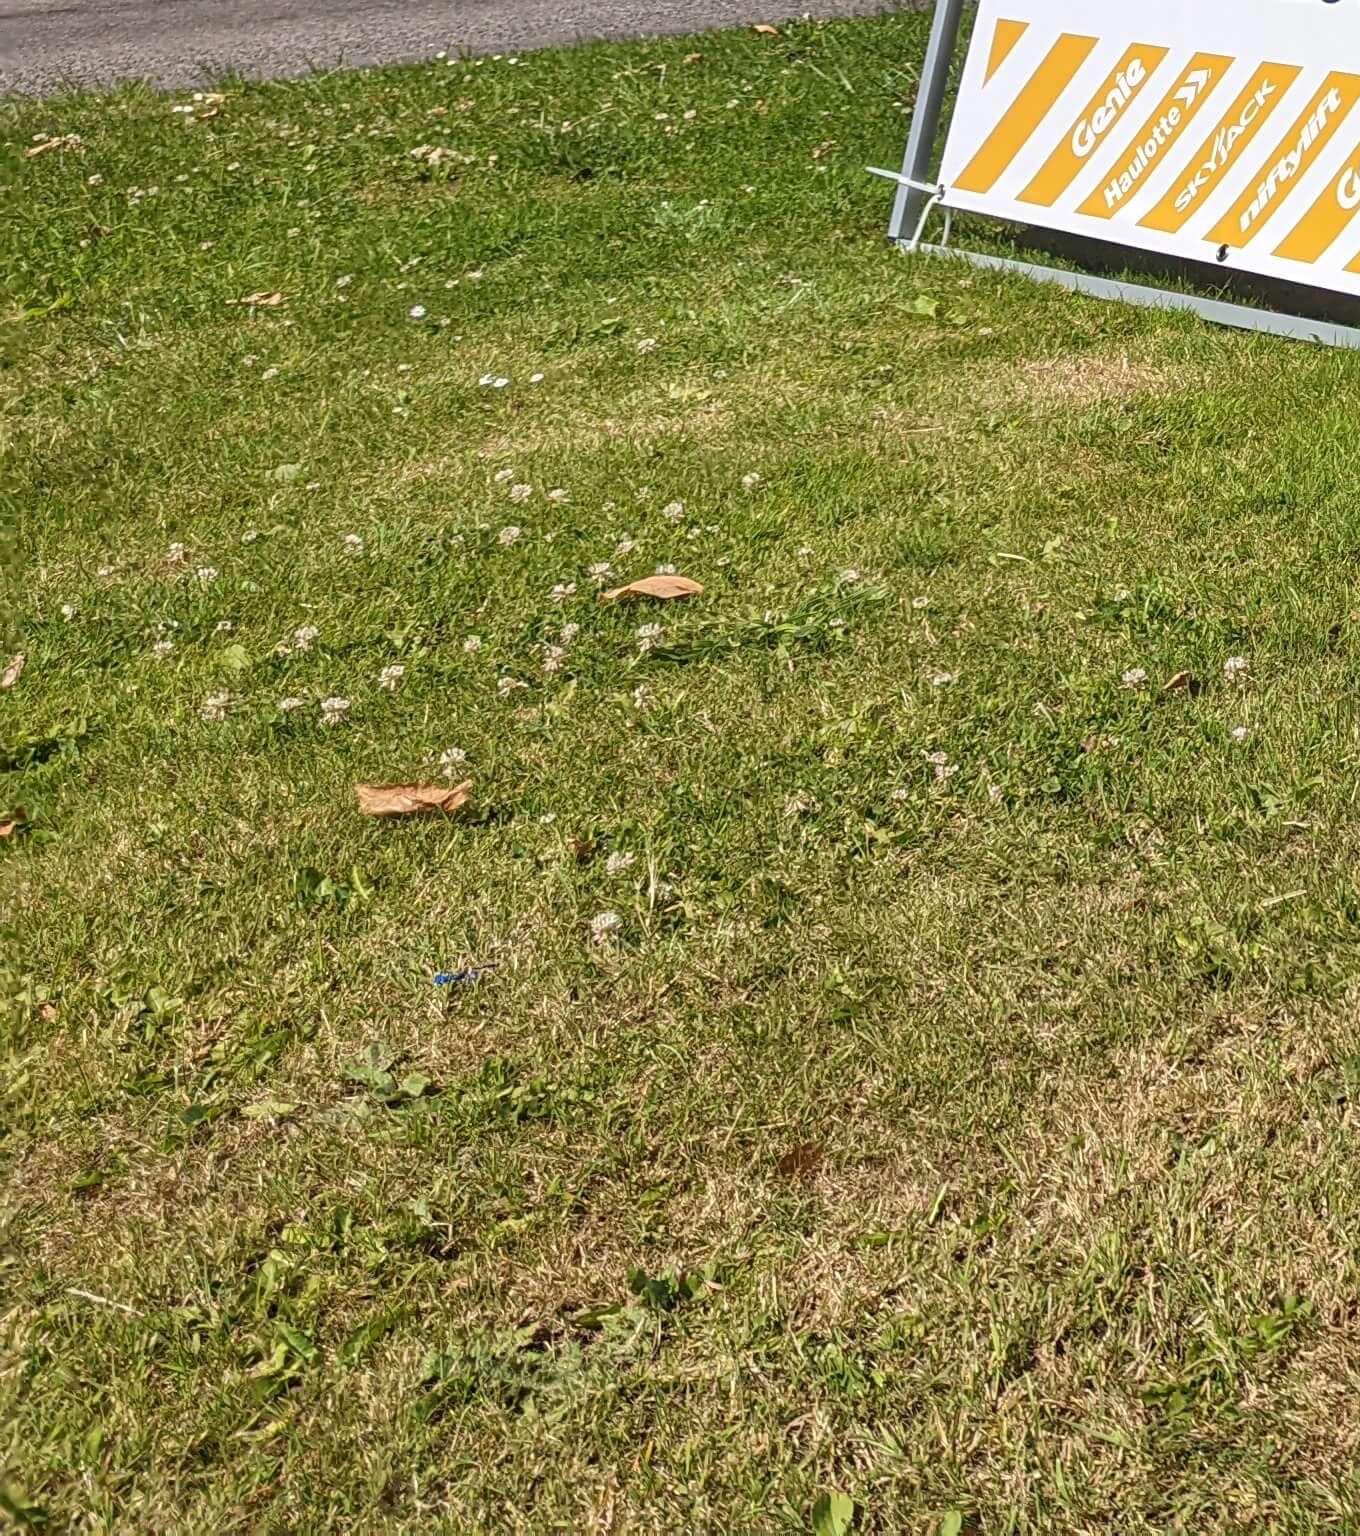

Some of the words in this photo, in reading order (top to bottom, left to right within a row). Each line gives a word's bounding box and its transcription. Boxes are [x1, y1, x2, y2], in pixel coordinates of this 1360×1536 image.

[1071, 57, 1146, 158] Genie
[1103, 107, 1182, 210] Haulotte
[1239, 87, 1341, 232] niftylift
